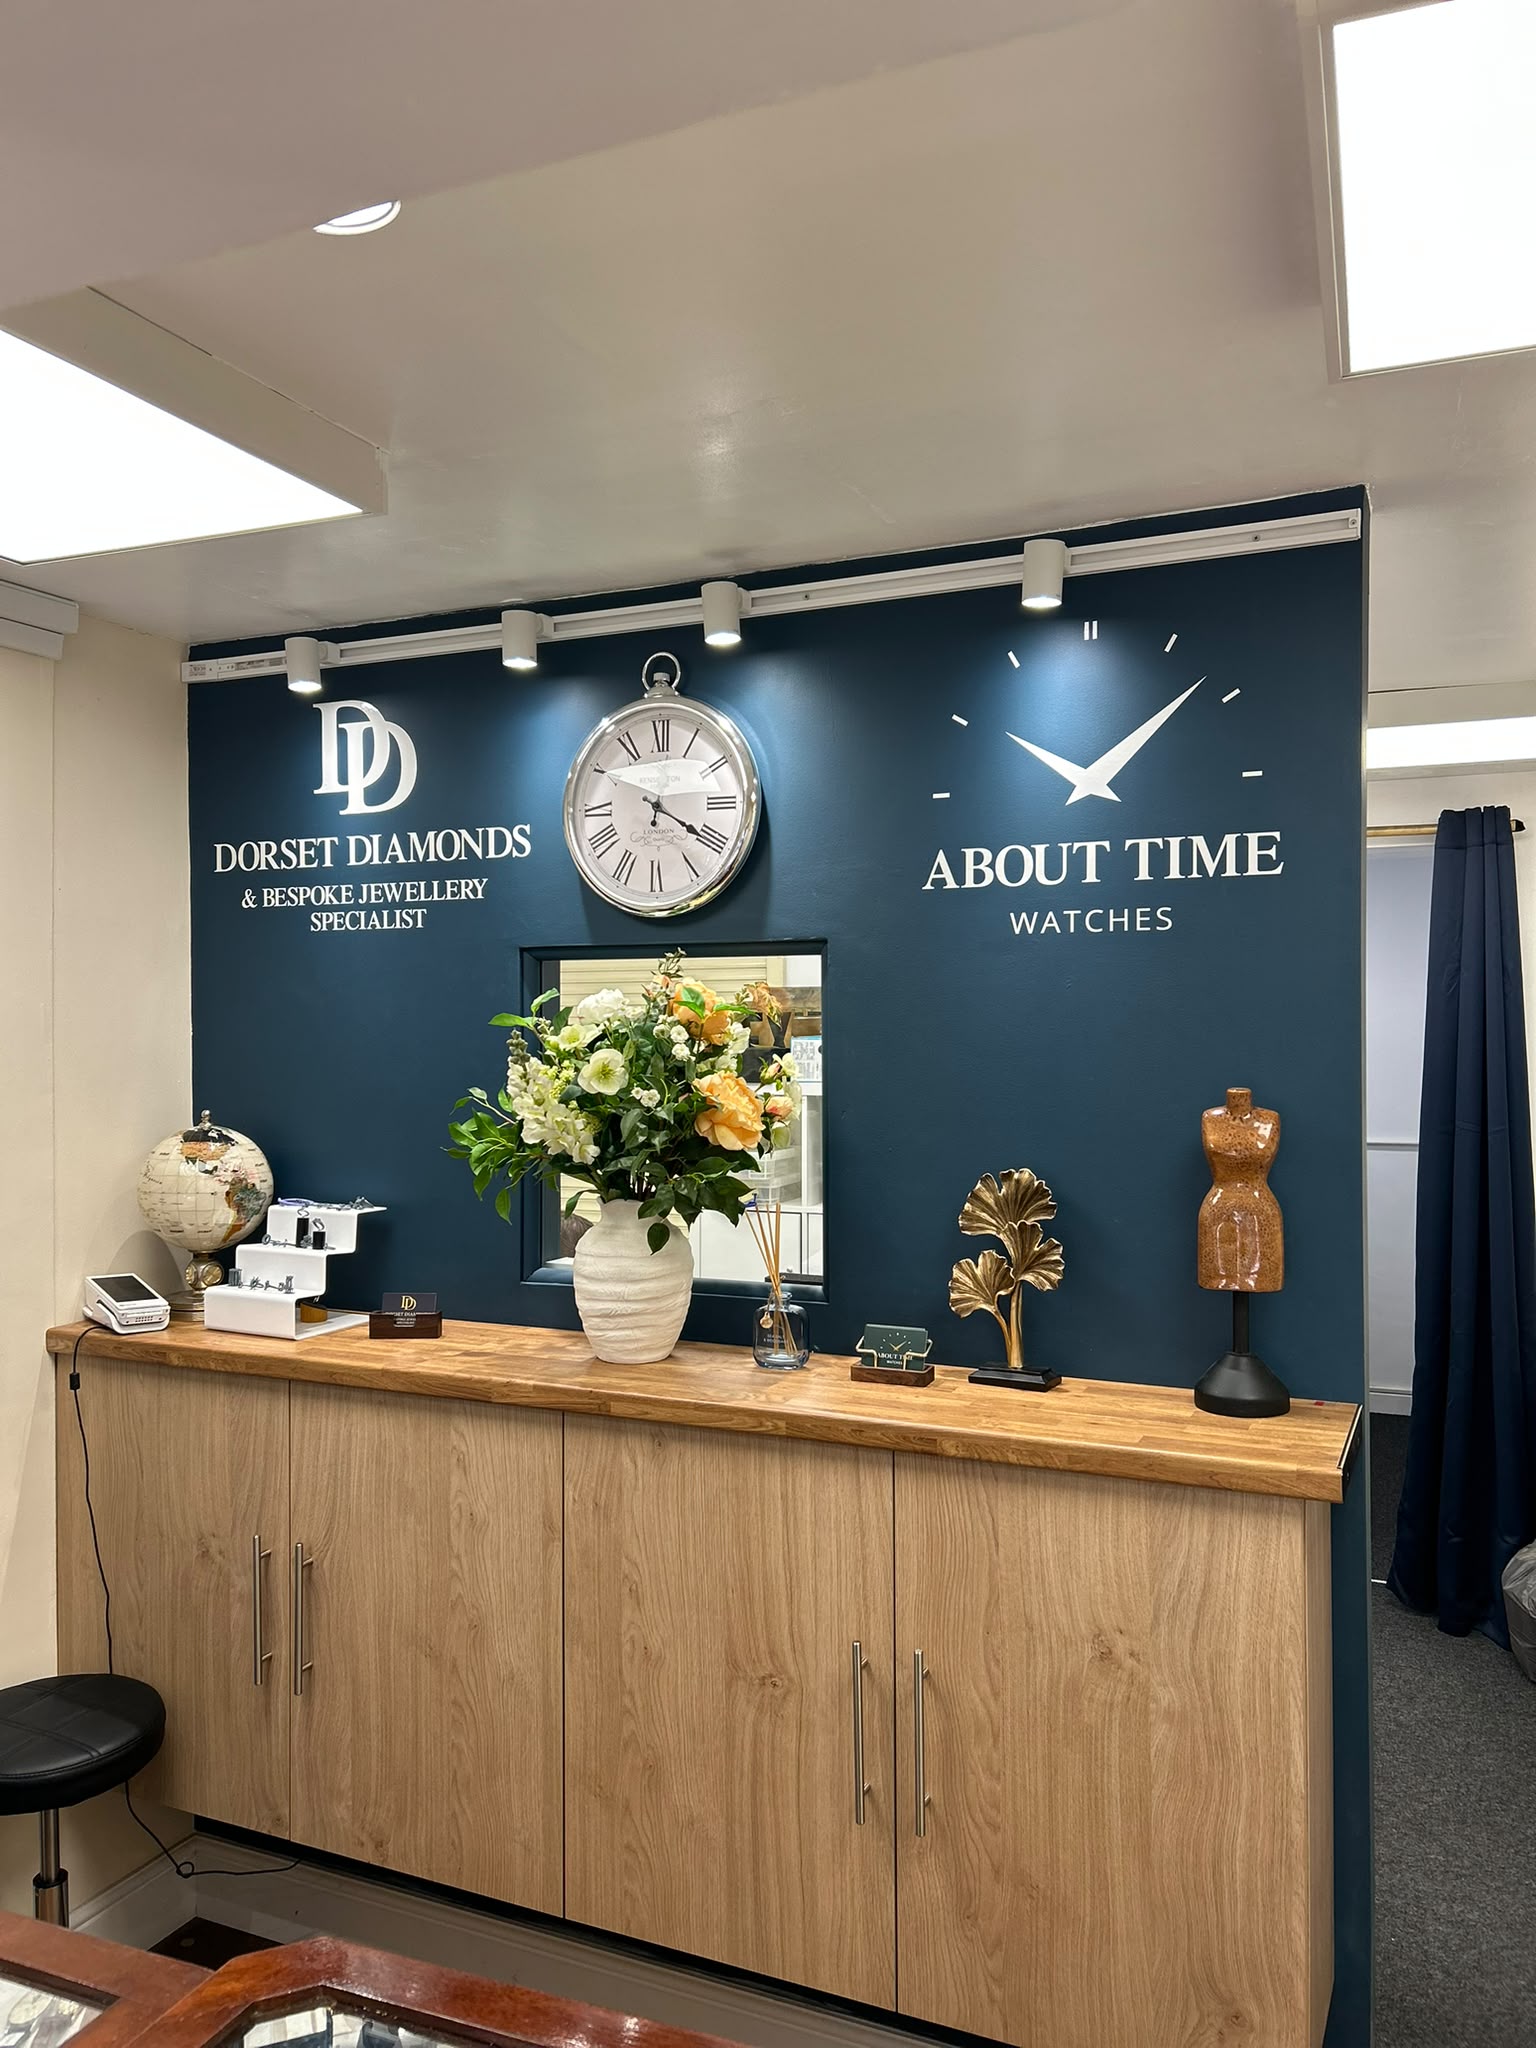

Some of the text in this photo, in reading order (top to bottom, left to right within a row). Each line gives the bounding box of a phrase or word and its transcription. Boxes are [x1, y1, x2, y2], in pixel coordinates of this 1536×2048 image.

[213, 823, 532, 873] DORSET DIAMONDS
[921, 831, 1285, 890] ABOUT TIME
[241, 877, 489, 909] & BESPOKE JEWELLERY
[310, 908, 428, 932] SPECIALIST
[1009, 906, 1173, 935] WATCHES
